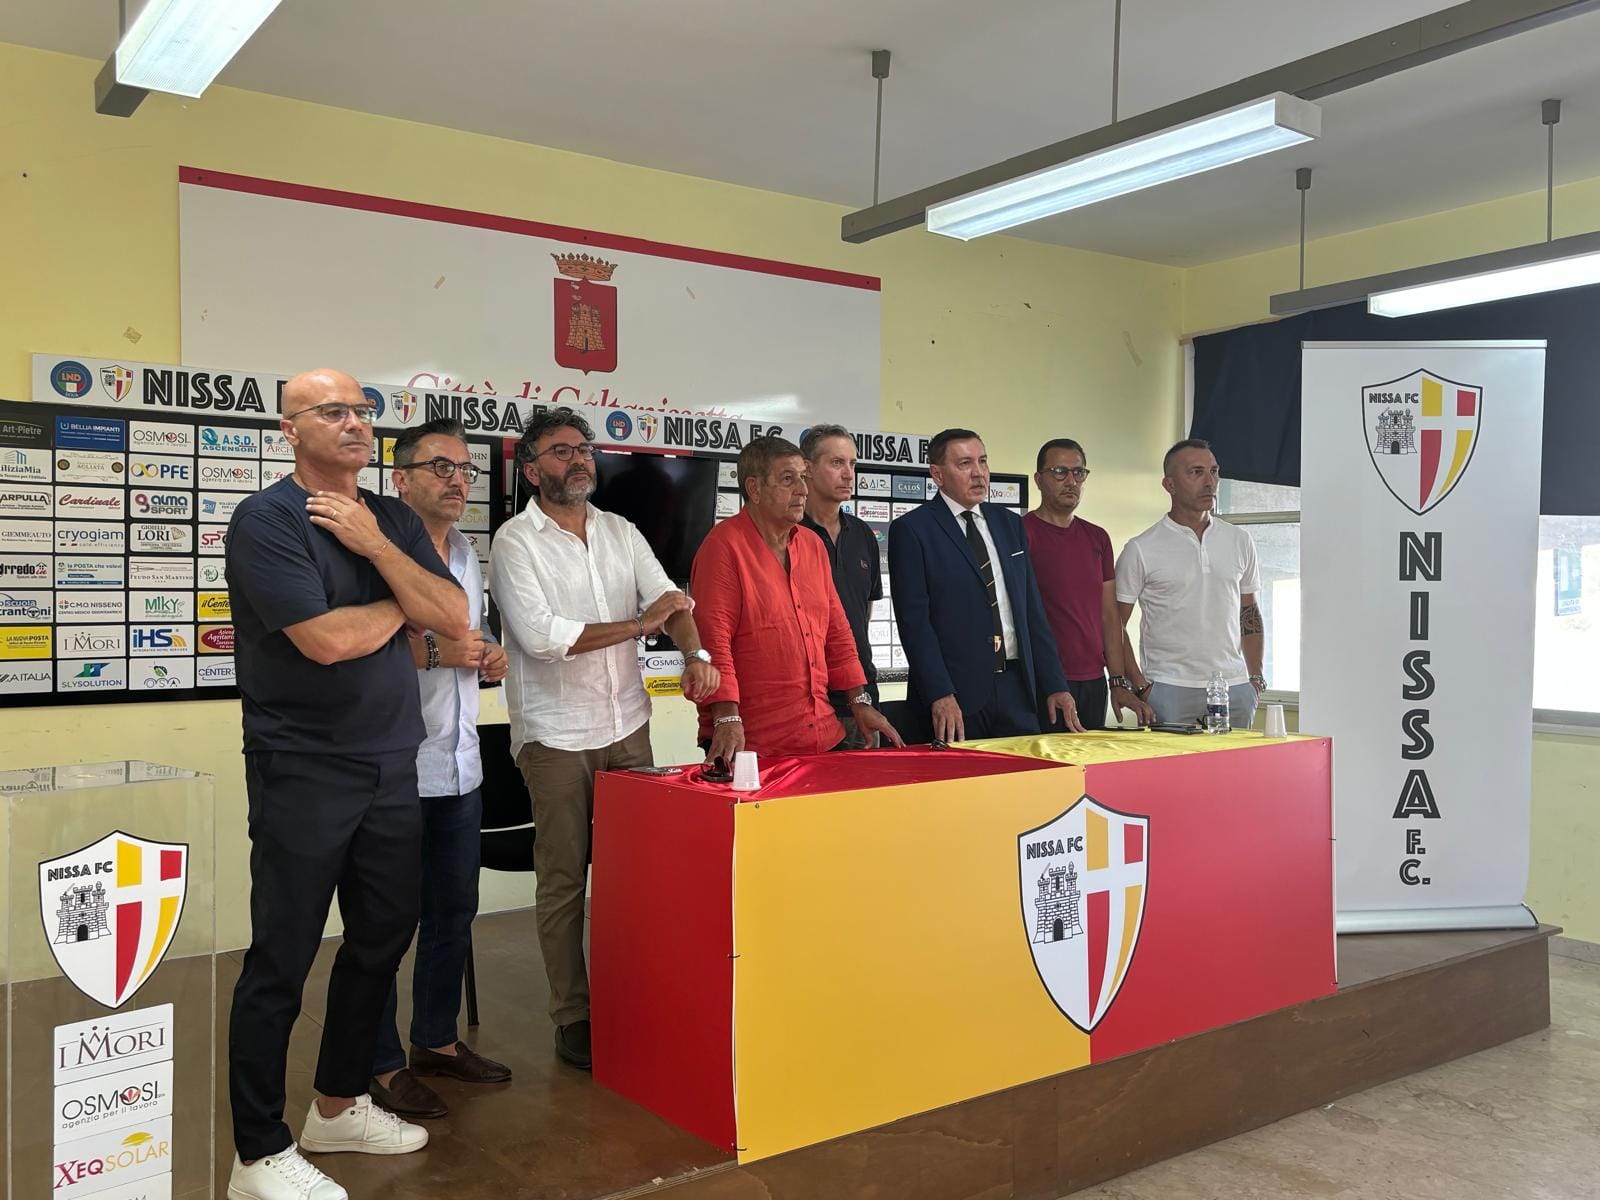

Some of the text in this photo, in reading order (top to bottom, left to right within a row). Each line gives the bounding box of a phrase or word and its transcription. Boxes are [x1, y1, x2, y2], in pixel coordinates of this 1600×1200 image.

[143, 367, 266, 413] NISSA
[1369, 392, 1419, 404] NISSA FC
[425, 393, 524, 438] NISSA
[71, 423, 120, 433] BELLIA IMPIANTI
[663, 416, 742, 451] NISSA
[222, 433, 254, 446] A.S.D.
[160, 464, 189, 480] PFE
[59, 494, 121, 507] Cardinale
[151, 495, 187, 506] alma
[58, 529, 124, 542] cryogiam
[137, 530, 170, 541] LORI
[74, 637, 121, 650] MORI
[133, 629, 173, 648] iHS
[1392, 531, 1442, 819] NISSA
[62, 680, 122, 688] SLYSOLUTION
[1026, 836, 1083, 860] NISSA FC
[48, 861, 113, 881] NISSA FC
[59, 1028, 166, 1069] I MORI
[62, 1080, 159, 1120] OSMOSI
[62, 1115, 100, 1129] agenzia
[103, 1110, 118, 1119] per
[130, 1100, 158, 1112] lavoro
